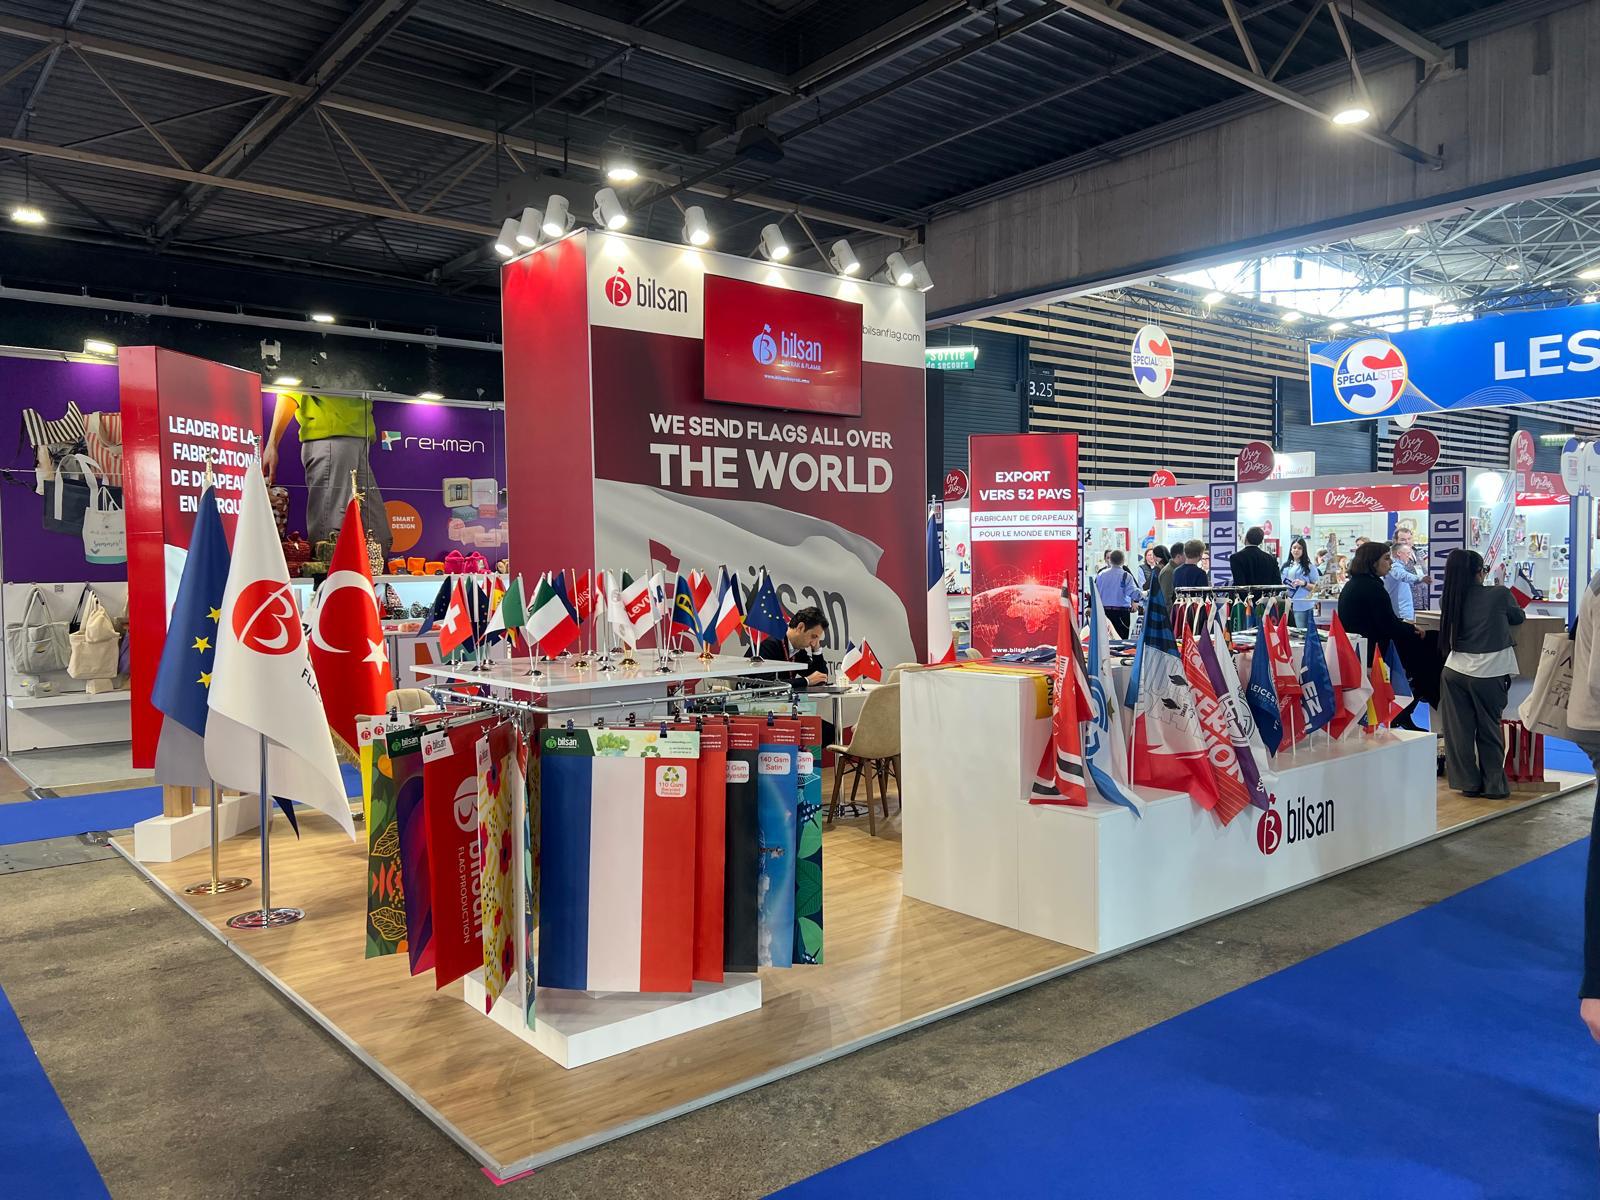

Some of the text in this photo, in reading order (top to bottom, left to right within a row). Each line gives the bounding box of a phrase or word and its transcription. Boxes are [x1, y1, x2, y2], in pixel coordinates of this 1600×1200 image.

[636, 276, 688, 314] bilsan
[781, 331, 822, 363] bilsan
[1494, 329, 1600, 381] LES
[937, 361, 969, 369] secours
[1337, 368, 1405, 386] SPECIALISTES
[1029, 381, 1053, 397] 3.25
[169, 416, 257, 446] LEADER DE LA
[650, 413, 893, 449] WE SEND FLAGS ALL OVER
[650, 443, 893, 494] THE WORLD
[995, 471, 1051, 483] EXPORT
[171, 469, 190, 487] DE
[979, 488, 1072, 501] VERS 52 PAYS
[180, 495, 198, 513] EN
[974, 513, 1075, 523] FABRICANT DE DRAPEAUX
[979, 530, 1002, 538] POUR
[1013, 529, 1043, 538] MONDE
[1044, 529, 1073, 537] ENTIER
[401, 736, 419, 747] bilsan
[432, 739, 447, 750] bilsan
[557, 736, 577, 746] bilsan
[1286, 795, 1335, 844] bilsan
[457, 846, 470, 944] FLAG PRODUCTION
